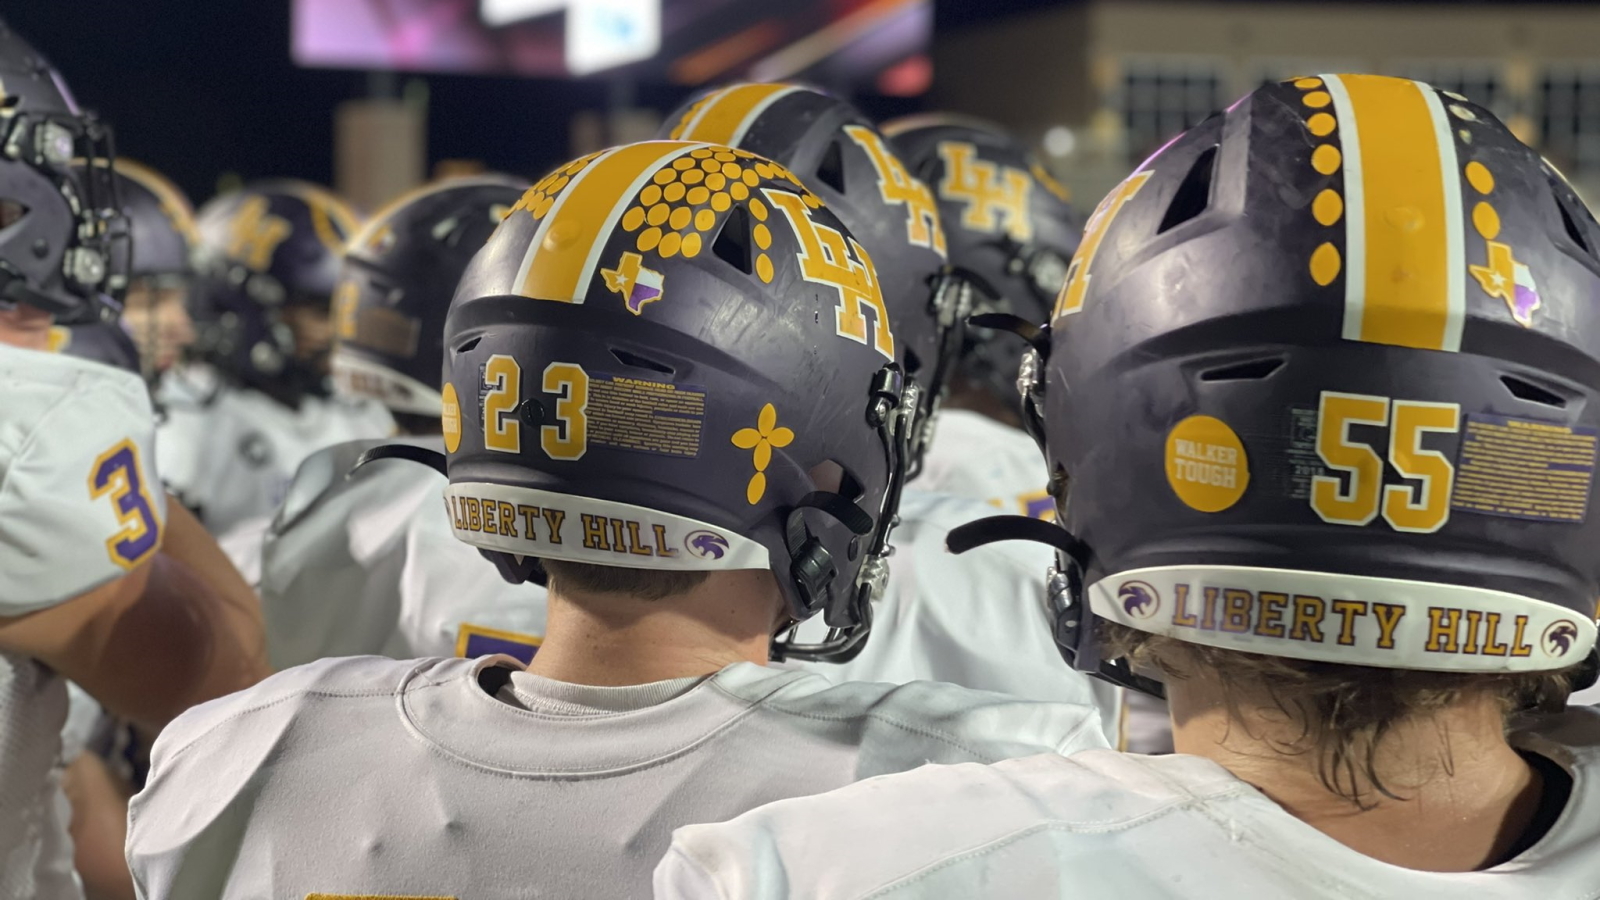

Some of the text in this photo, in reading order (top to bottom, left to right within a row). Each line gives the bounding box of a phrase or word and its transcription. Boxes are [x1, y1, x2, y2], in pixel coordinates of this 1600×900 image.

[937, 141, 1032, 243] LH
[760, 187, 895, 363] LH
[612, 376, 676, 390] WARNING
[1174, 438, 1237, 465] WALKER
[1174, 457, 1237, 488] TOUGH
[1310, 390, 1460, 534] 55
[87, 436, 165, 572] 3
[451, 495, 679, 558] LIBERTY HILL
[1171, 583, 1533, 657] LIBERTY HILL
